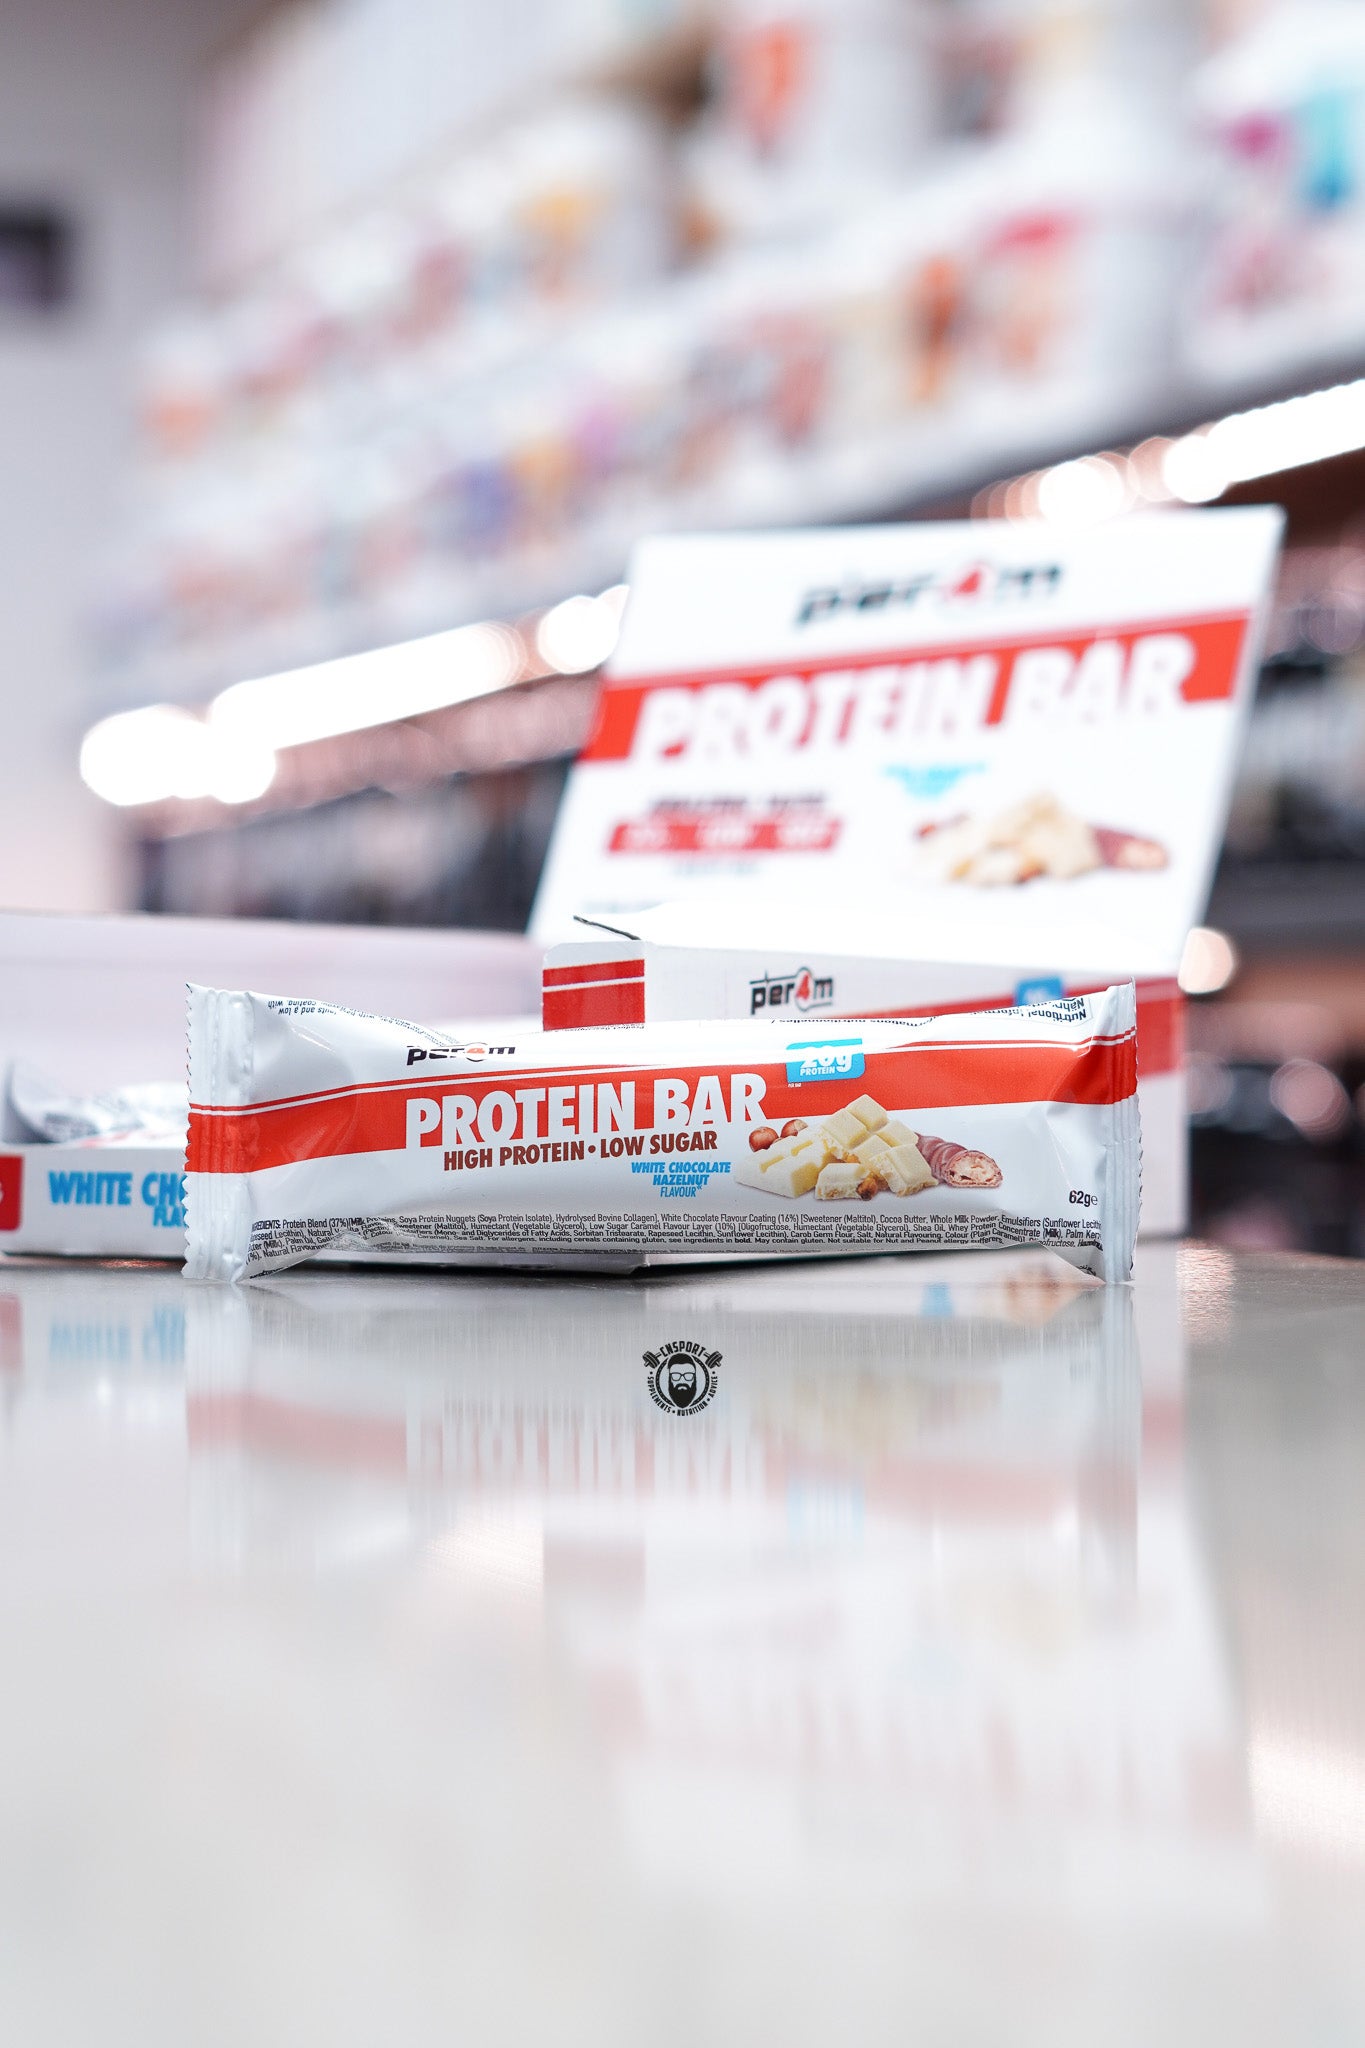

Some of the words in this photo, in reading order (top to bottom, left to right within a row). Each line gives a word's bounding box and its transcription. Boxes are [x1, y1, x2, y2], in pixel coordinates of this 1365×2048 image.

[630, 652, 1000, 765] PROTEIN
[1000, 632, 1195, 730] BAR
[751, 968, 833, 1015] per4m
[267, 1000, 283, 1010] with
[278, 1006, 292, 1015] low
[1027, 1008, 1087, 1023] Nutritional
[799, 1066, 836, 1076] PROTEIN
[406, 1081, 636, 1149] PROTEIN
[653, 1072, 769, 1130] BAR
[444, 1148, 493, 1171] HIGH
[499, 1141, 585, 1166] PROTEIN
[600, 1135, 644, 1158] LOW
[650, 1130, 718, 1154] SUGAR
[631, 1162, 666, 1174] WHITE
[668, 1162, 731, 1174] CHOCOLATE
[652, 1174, 710, 1186] HAZELNUT
[48, 1170, 134, 1206] WHITE
[282, 1218, 307, 1229] Protein
[308, 1218, 328, 1228] Blend
[399, 1216, 417, 1224] Soya
[418, 1214, 444, 1223] Protein
[446, 1214, 476, 1224] Nuggets
[478, 1214, 497, 1224] (Soya
[498, 1214, 524, 1222] Protein
[525, 1214, 553, 1224] Isolate),
[556, 1214, 596, 1224] Hydrolysed
[598, 1214, 622, 1222] Bovine
[661, 1214, 682, 1222] White
[683, 1214, 719, 1222] Chocolate
[720, 1214, 748, 1222] Flavour
[749, 1214, 776, 1224] Coating
[778, 1214, 799, 1224] (16%)
[800, 1214, 842, 1224] [Sweetener
[880, 1215, 902, 1224] Cocoa
[930, 1215, 953, 1224] Whole
[954, 1215, 969, 1224] Milk
[1002, 1215, 1041, 1227] Emulsifiers
[1042, 1218, 1081, 1229] (Sunflower
[308, 1228, 334, 1237] Natural
[512, 1223, 550, 1231] (Vegetable
[606, 1223, 628, 1231] Sugar
[692, 1223, 713, 1231] Layer
[715, 1223, 736, 1231] (10%)
[836, 1224, 874, 1232] (Vegetable
[948, 1224, 968, 1232] Whey
[970, 1222, 996, 1231] Protein
[998, 1222, 1041, 1238] Concentrate
[1066, 1229, 1084, 1239] Palm
[970, 1230, 991, 1240] (Plain
[263, 1249, 290, 1258] Natural
